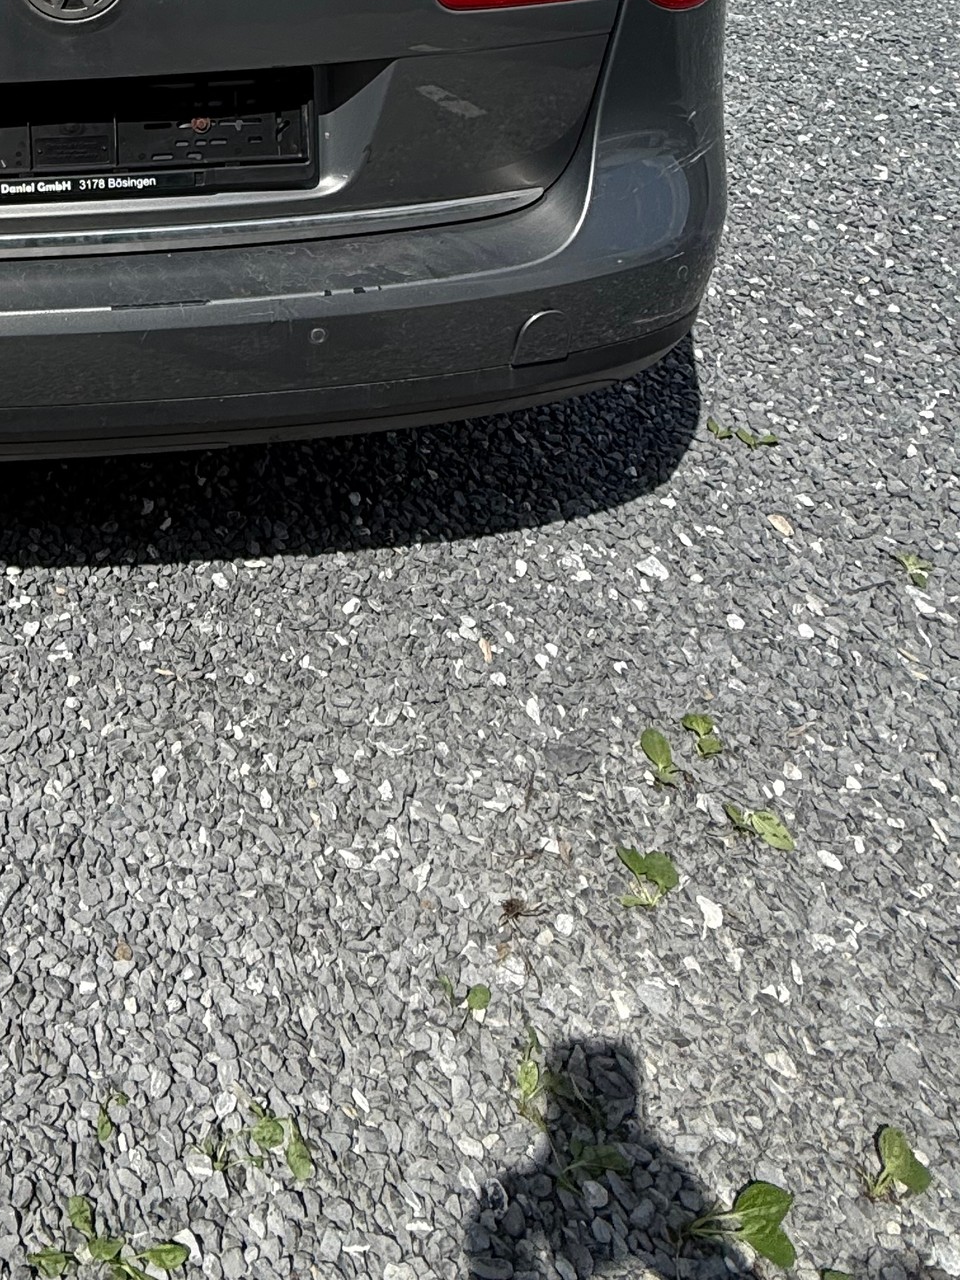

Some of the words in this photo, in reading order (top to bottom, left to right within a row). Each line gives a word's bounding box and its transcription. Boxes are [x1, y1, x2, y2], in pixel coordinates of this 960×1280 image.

[0, 182, 35, 195] Daniel
[36, 180, 72, 193] GmbH
[79, 178, 105, 190] 3178
[108, 177, 156, 190] Bösingen
